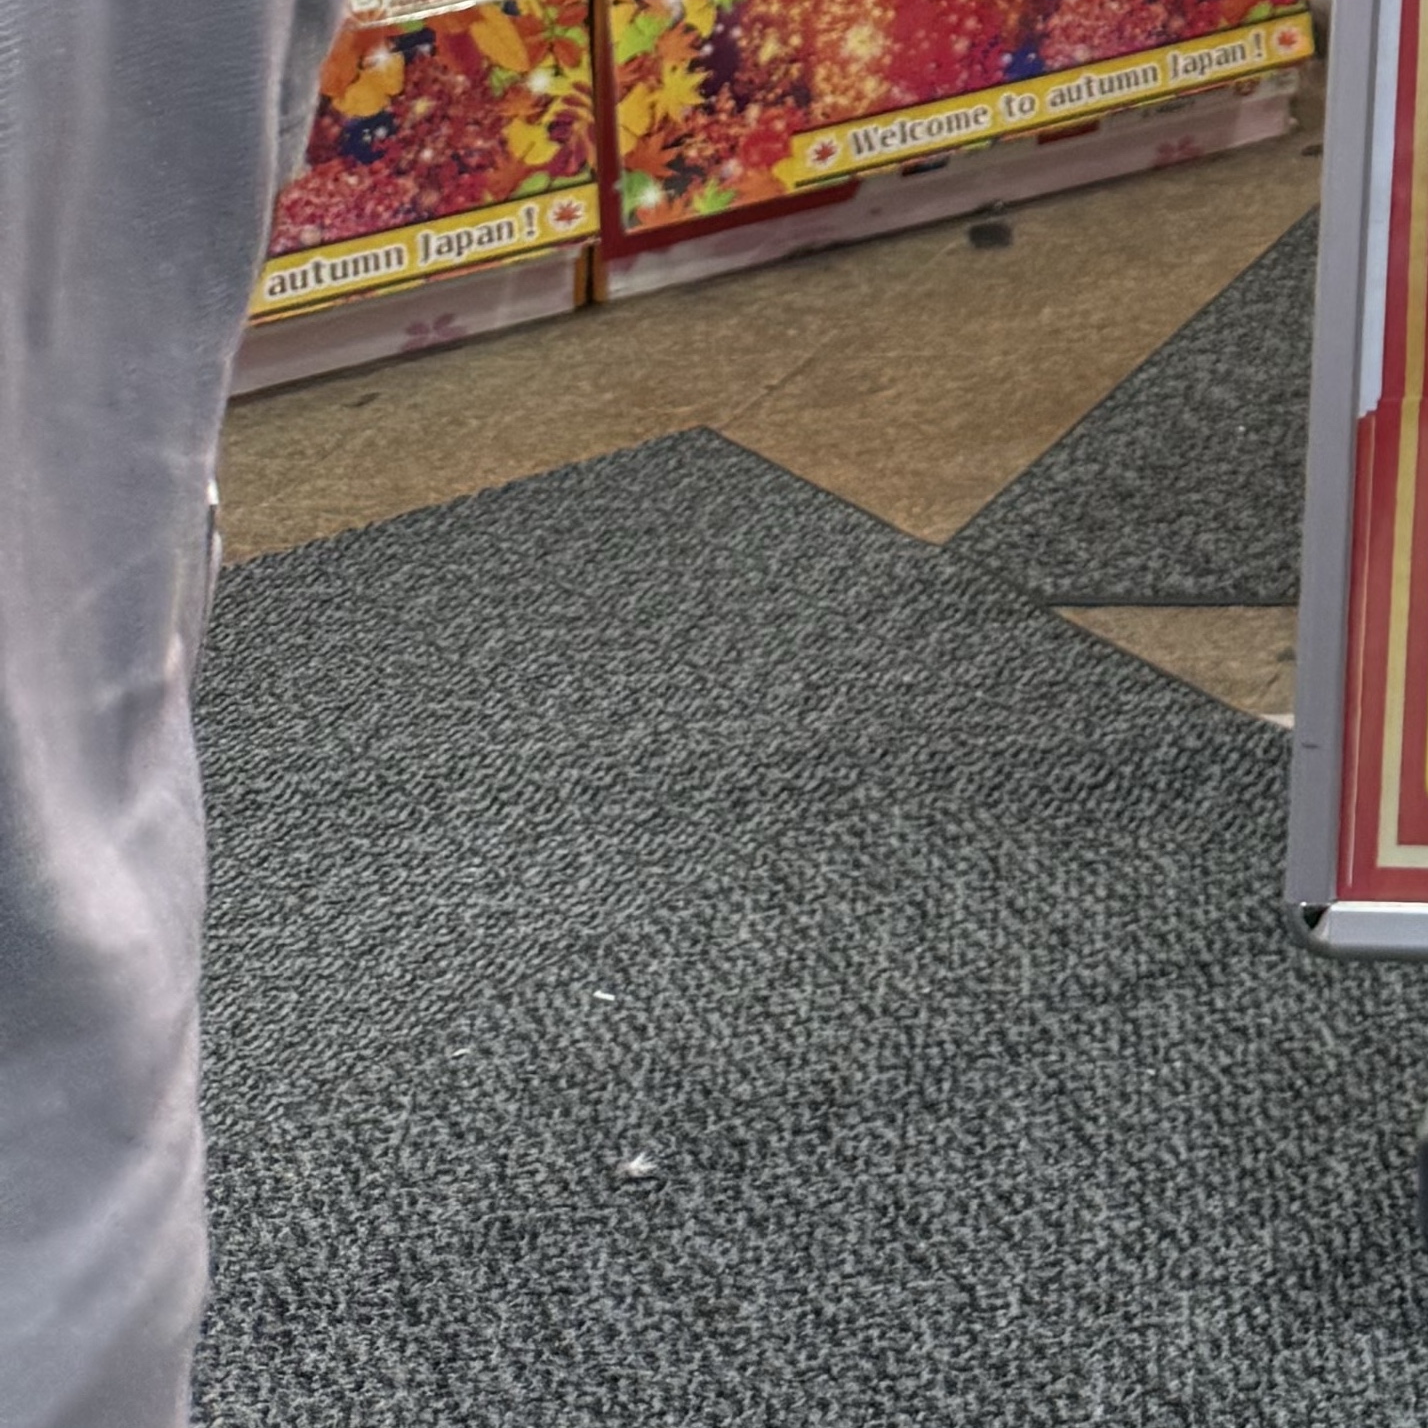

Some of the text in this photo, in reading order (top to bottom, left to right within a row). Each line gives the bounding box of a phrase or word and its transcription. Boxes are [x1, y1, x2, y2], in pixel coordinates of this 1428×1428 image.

[852, 108, 990, 158] Welcome
[1003, 92, 1038, 119] to
[1050, 68, 1160, 110] autumn
[1168, 46, 1248, 81] Japan
[267, 243, 405, 299] autumn
[419, 216, 516, 264] Japan
